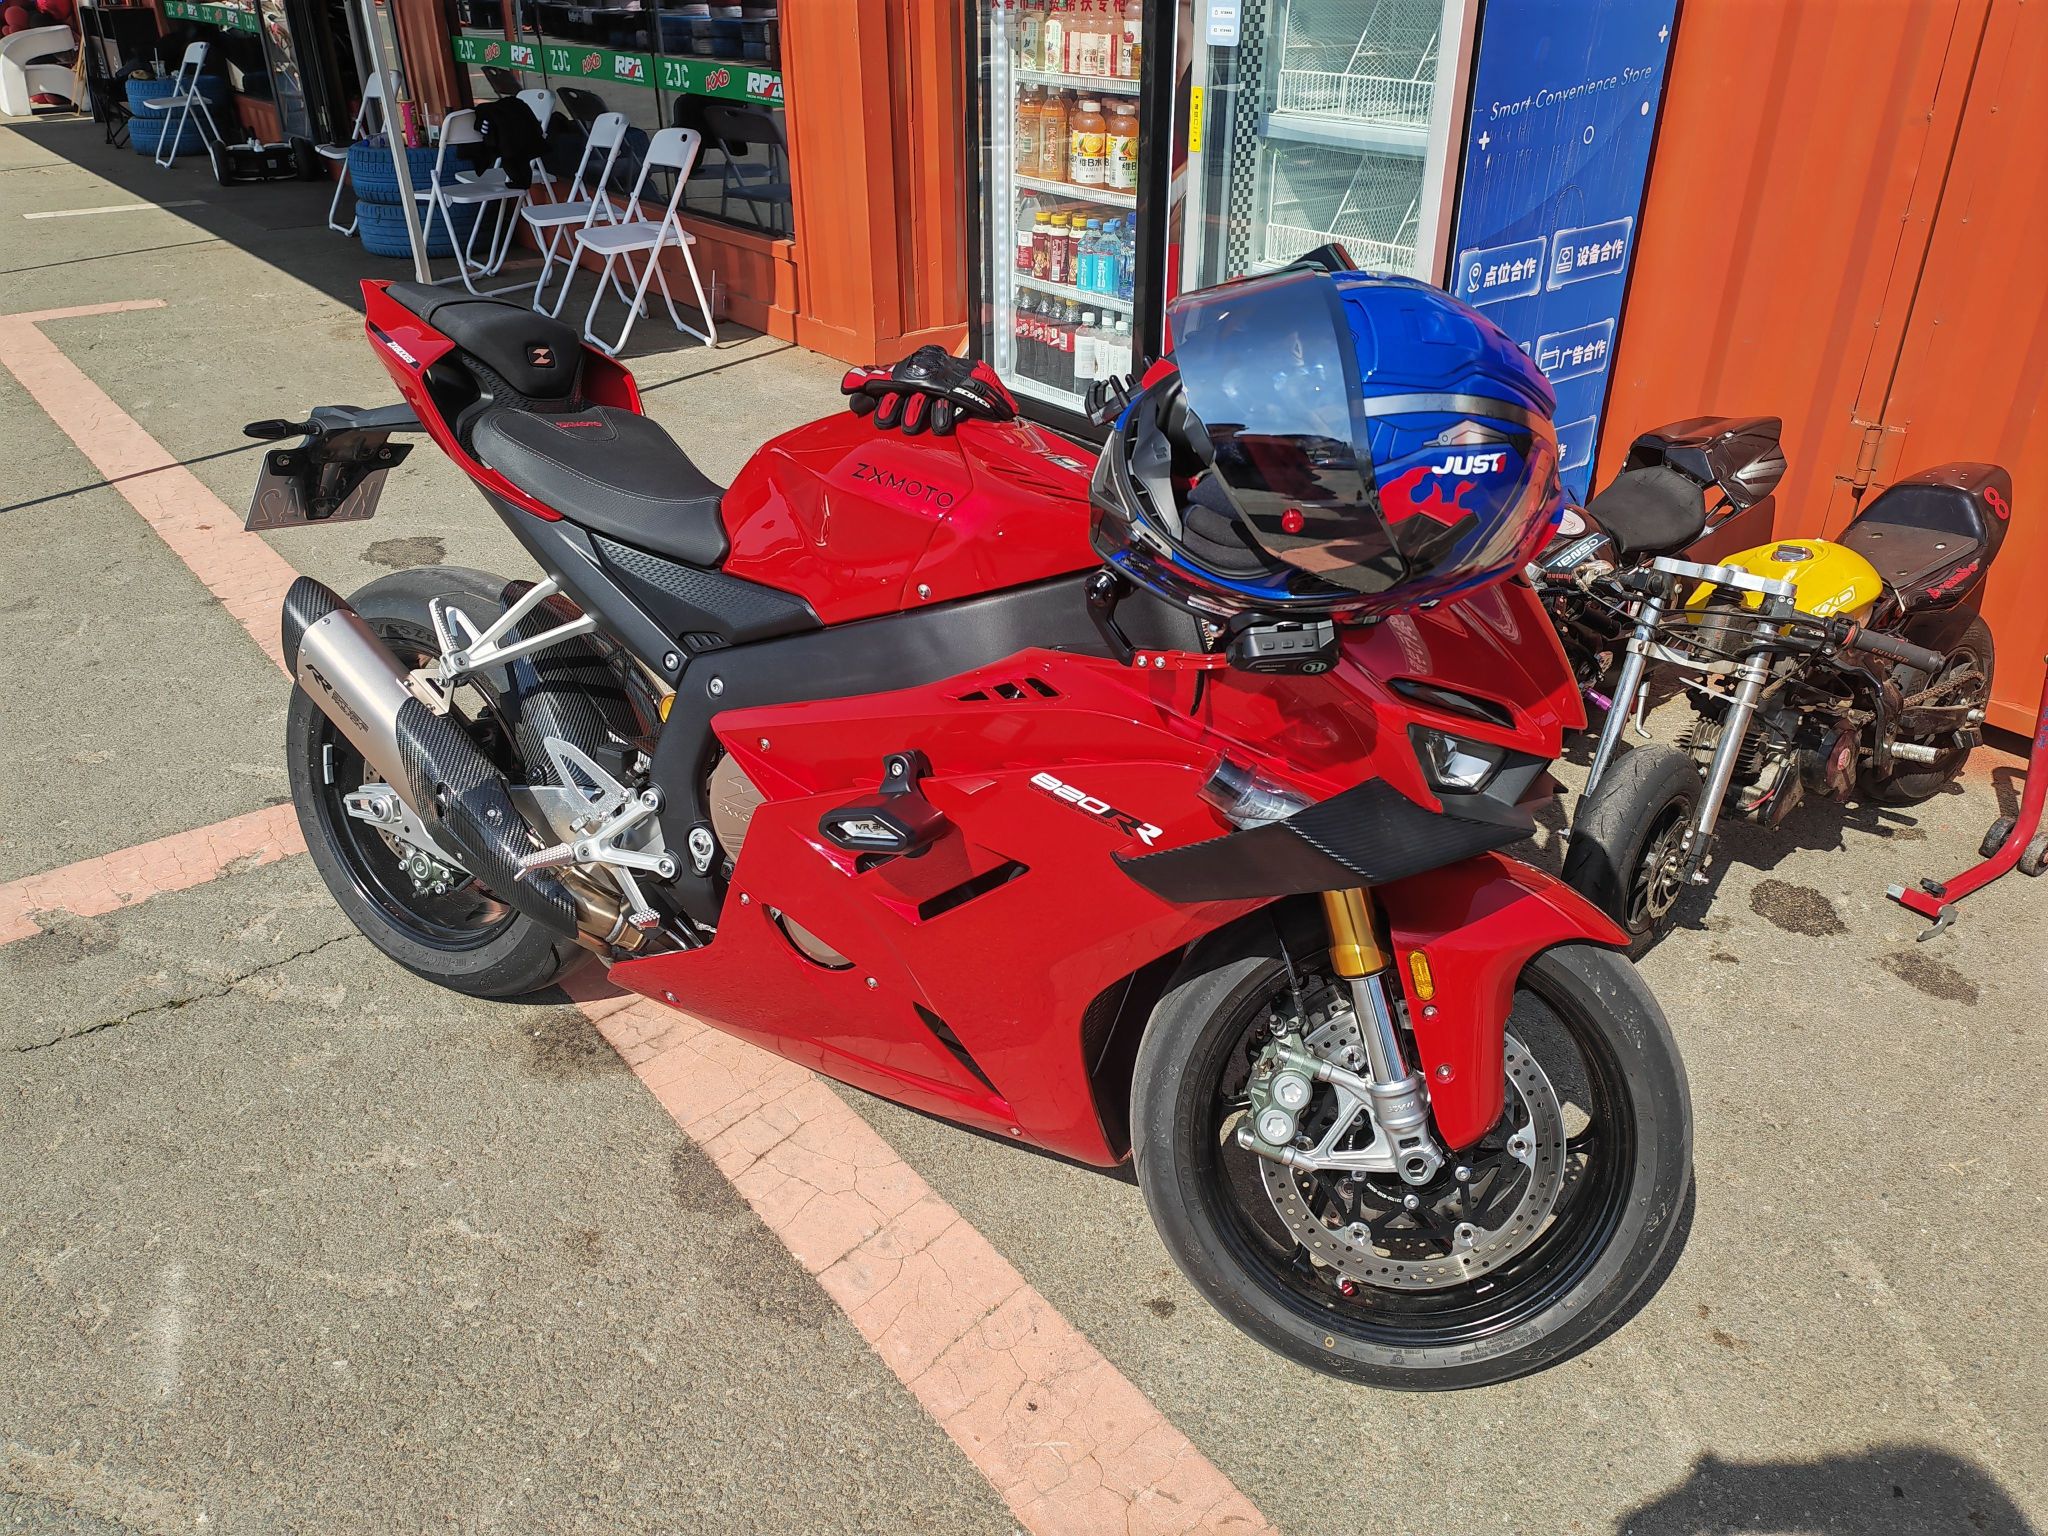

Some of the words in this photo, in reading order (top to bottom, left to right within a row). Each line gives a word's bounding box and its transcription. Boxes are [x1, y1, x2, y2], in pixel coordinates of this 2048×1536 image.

[458, 40, 476, 60] ZJC
[510, 45, 534, 65] RPA
[550, 50, 570, 72] ZJC
[581, 52, 602, 75] KXD
[615, 55, 643, 78] RPA
[664, 62, 690, 88] ZJC
[705, 68, 730, 93] KXD
[747, 71, 783, 98] RPA
[1490, 95, 1532, 121] Smart
[1535, 75, 1618, 109] Convenience
[1621, 66, 1653, 87] Store
[1576, 238, 1625, 268] 设备合作
[1482, 257, 1538, 289] 点位合作
[1558, 338, 1607, 369] 广告合作
[852, 462, 955, 509] ZXMOTO
[1983, 486, 2010, 520] 8
[1556, 537, 1600, 568] ENSO
